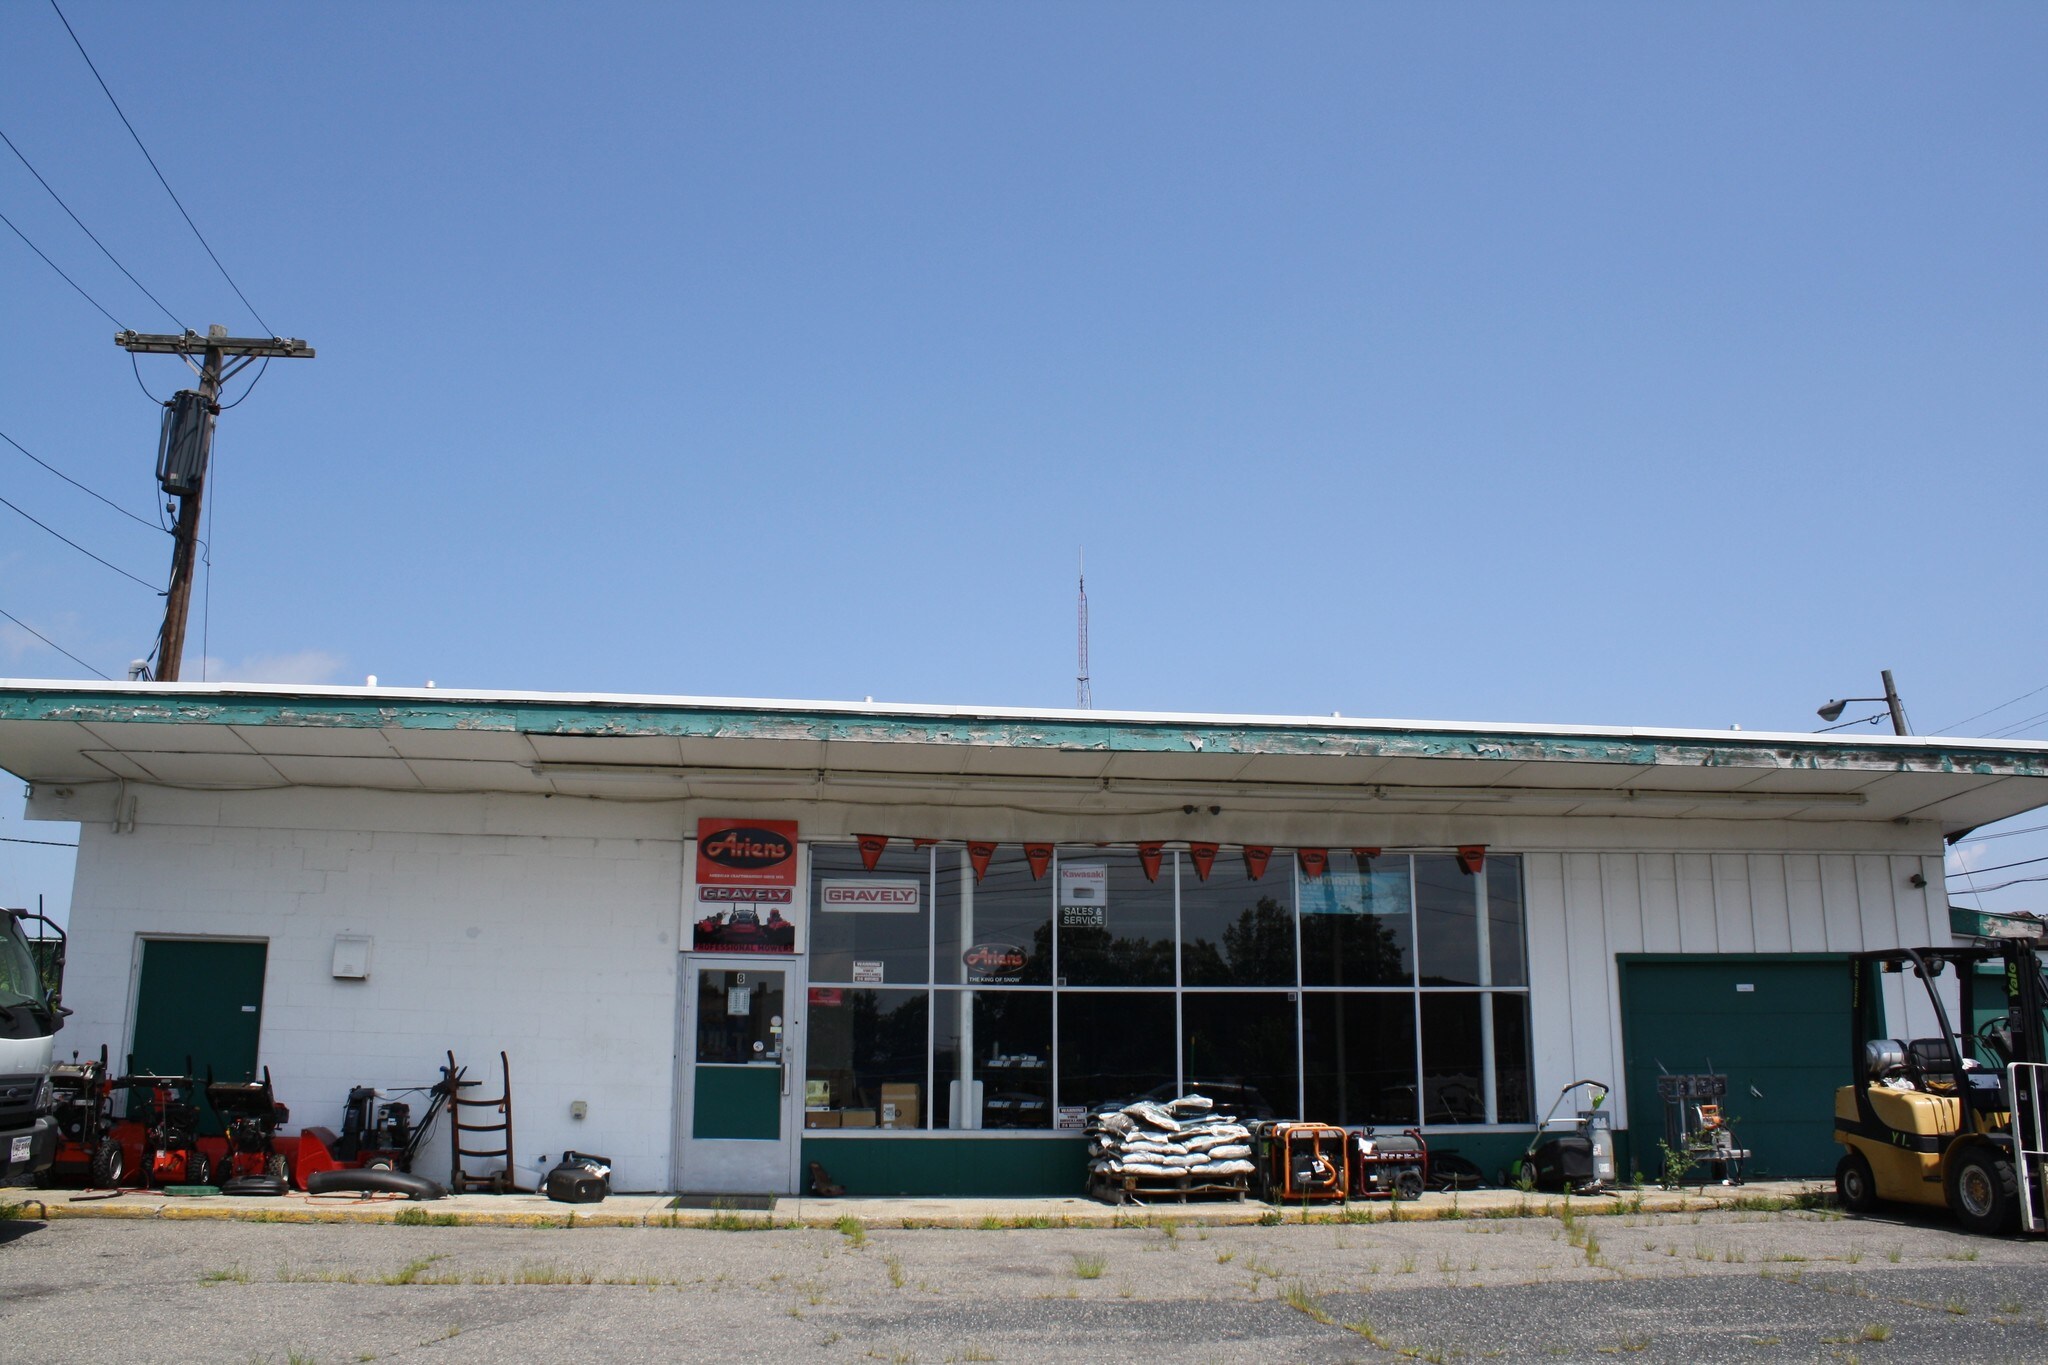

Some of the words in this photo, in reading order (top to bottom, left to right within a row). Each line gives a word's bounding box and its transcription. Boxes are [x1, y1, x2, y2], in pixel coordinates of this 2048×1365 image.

[706, 832, 786, 858] Ariens
[1062, 870, 1104, 878] Kawasaki
[703, 888, 788, 901] GRAVELY
[828, 890, 914, 902] GRAVELY
[1064, 907, 1094, 916] SALES
[1096, 907, 1103, 916] &
[1063, 916, 1104, 925] SERVICE
[967, 946, 1023, 967] Ariens
[737, 973, 746, 984] 8
